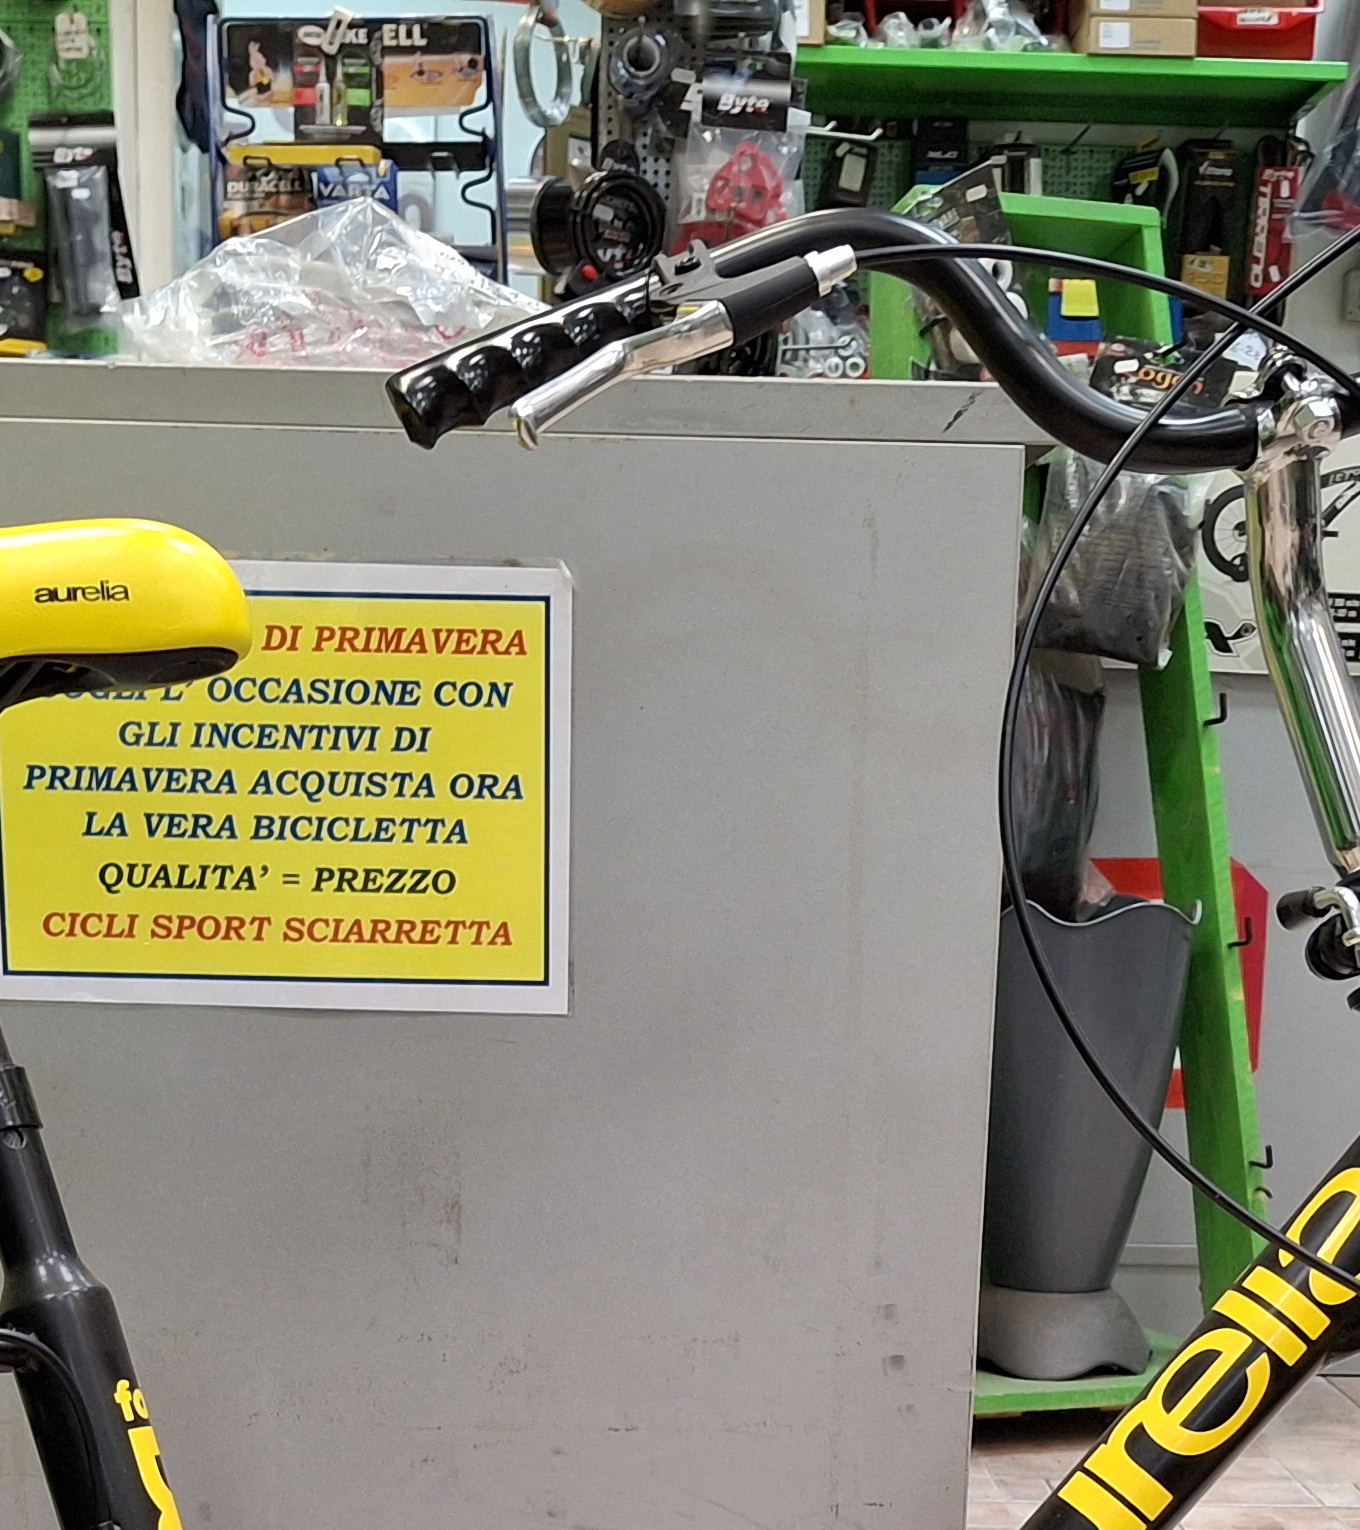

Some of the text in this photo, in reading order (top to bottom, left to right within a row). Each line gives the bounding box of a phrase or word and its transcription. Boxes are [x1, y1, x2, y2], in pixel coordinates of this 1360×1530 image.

[319, 182, 391, 200] VARTA
[34, 579, 130, 603] aurelia
[261, 625, 528, 656] DI PRIMAVERA
[207, 676, 421, 706] OCCASIONE
[434, 681, 513, 708] CON
[118, 721, 432, 752] GLI INCENTIVI DI
[22, 764, 524, 802] PRIMAVERA ACQUISTA ORA
[81, 811, 469, 845] LA VERA BICICLETTA
[311, 867, 457, 895] PREZZO
[42, 912, 513, 947] CICLI SPORT SCIARRETTA
